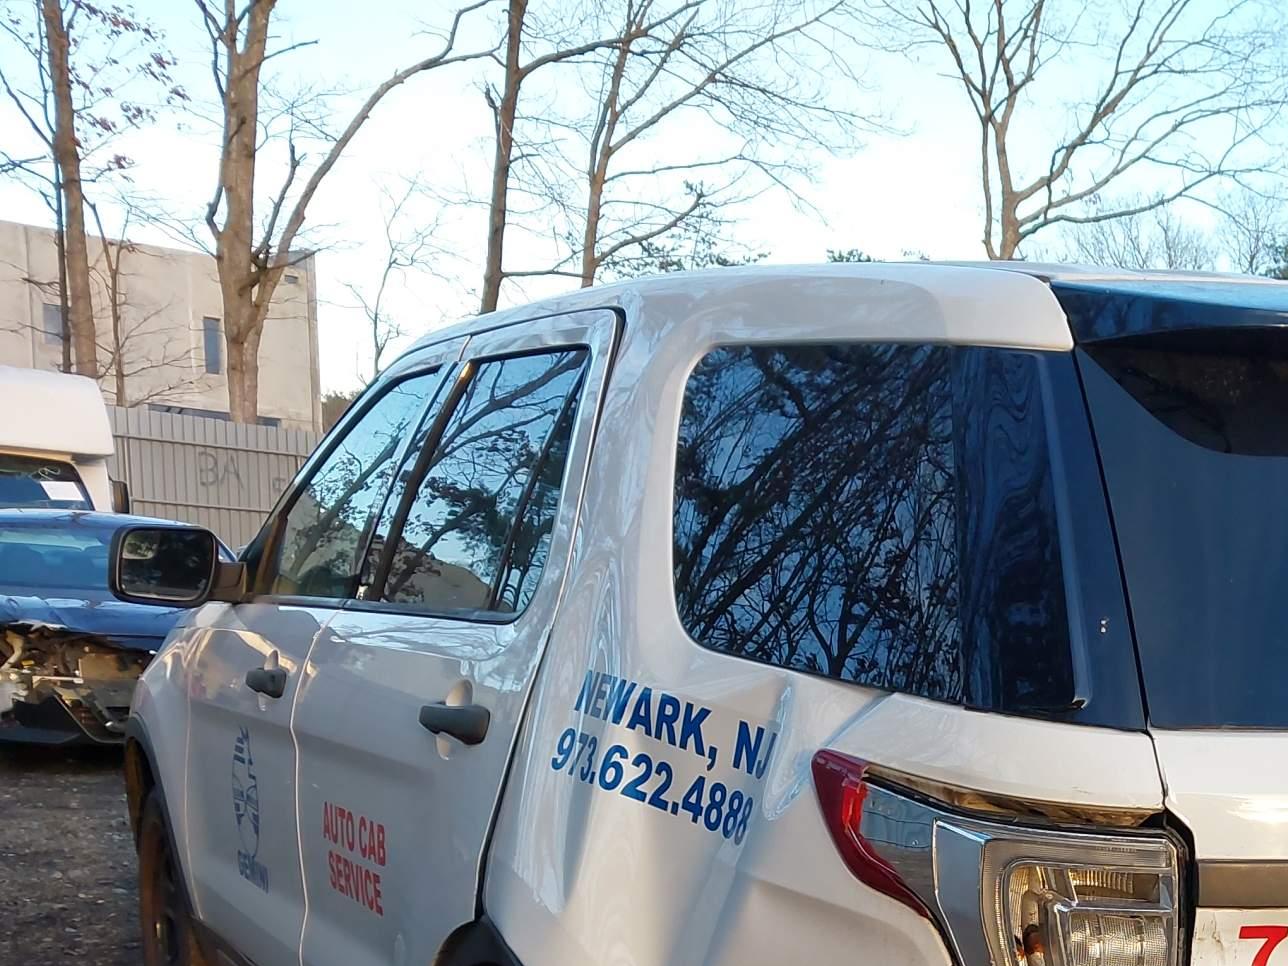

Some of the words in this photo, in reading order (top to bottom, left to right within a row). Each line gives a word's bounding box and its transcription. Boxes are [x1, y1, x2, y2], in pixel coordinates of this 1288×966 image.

[574, 669, 718, 771] NEWARK,
[733, 719, 778, 779] NJ
[551, 727, 754, 845] 973.622.4888
[323, 801, 355, 852] AUTO
[358, 815, 387, 867] CAB
[328, 850, 384, 916] SERVICE
